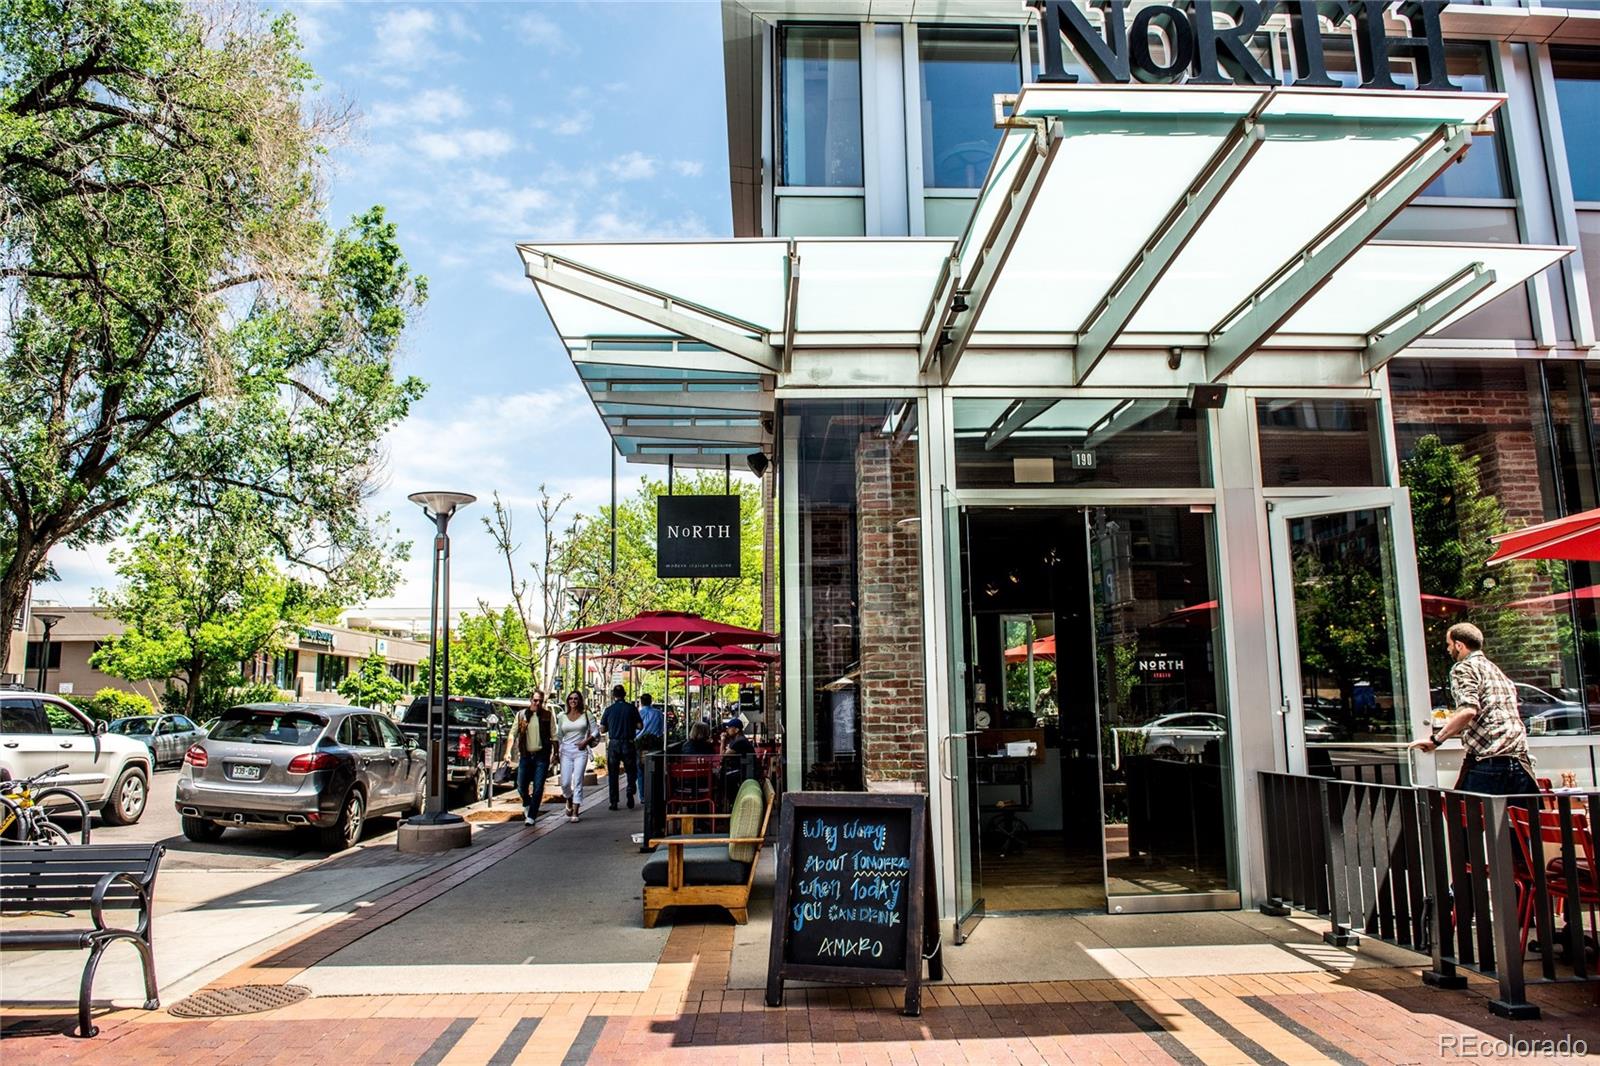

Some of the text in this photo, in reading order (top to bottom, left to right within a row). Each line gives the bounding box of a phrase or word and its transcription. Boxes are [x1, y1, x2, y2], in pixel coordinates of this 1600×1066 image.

[1076, 453, 1093, 466] 190
[803, 818, 838, 852] Why
[817, 937, 883, 958] AMARO
